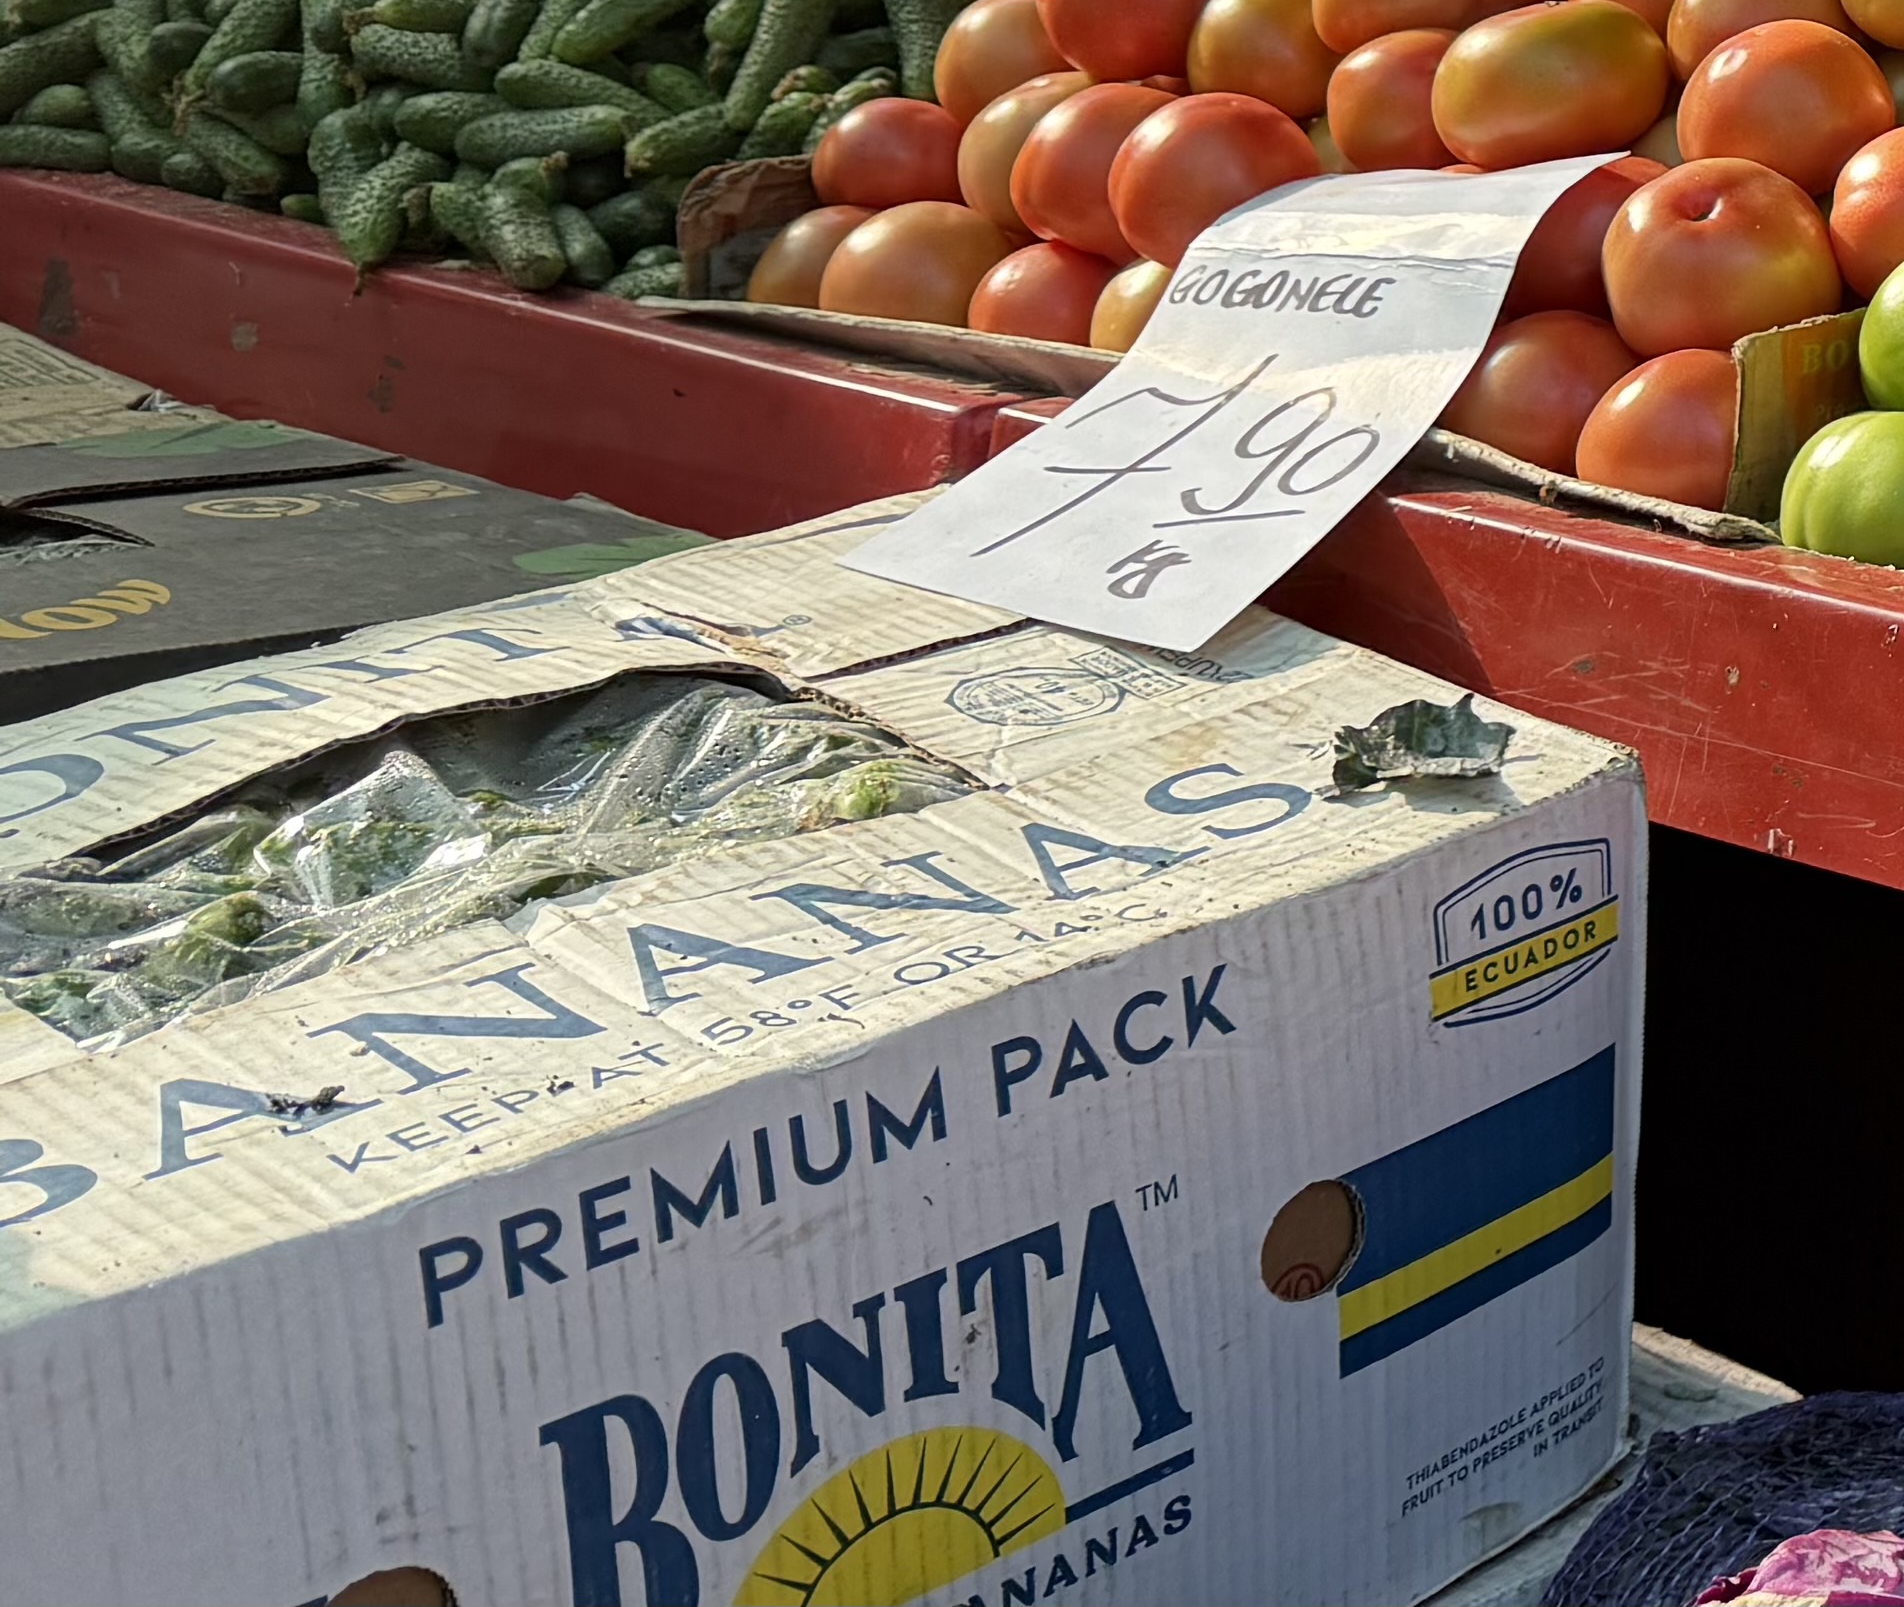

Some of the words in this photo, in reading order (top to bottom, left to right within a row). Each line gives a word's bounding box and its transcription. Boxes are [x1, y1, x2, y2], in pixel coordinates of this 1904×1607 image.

[970, 353, 1279, 558] 7
[1180, 386, 1382, 514] 90
[1464, 919, 1597, 993] ECUADOR
[1469, 866, 1584, 941] 100%
[326, 1085, 540, 1174] KEEP
[591, 1041, 672, 1091] AT
[893, 943, 1003, 988] OR
[417, 1065, 949, 1329] PREMIUM
[990, 962, 1238, 1118] PACK
[538, 1199, 1194, 1607] BONITA
[1400, 1478, 1444, 1519] FRUIT
[1447, 1465, 1469, 1488] TO
[1471, 1417, 1546, 1474] PRESERVE
[1548, 1377, 1605, 1427] QUALITY
[1405, 1407, 1528, 1491] THIABENDAZOLE
[1529, 1371, 1586, 1418] APPLIED
[1585, 1356, 1605, 1380] TO
[1532, 1438, 1549, 1459] IN
[1552, 1396, 1605, 1445] TRANSIT
[952, 1494, 1193, 1607] NANAS
